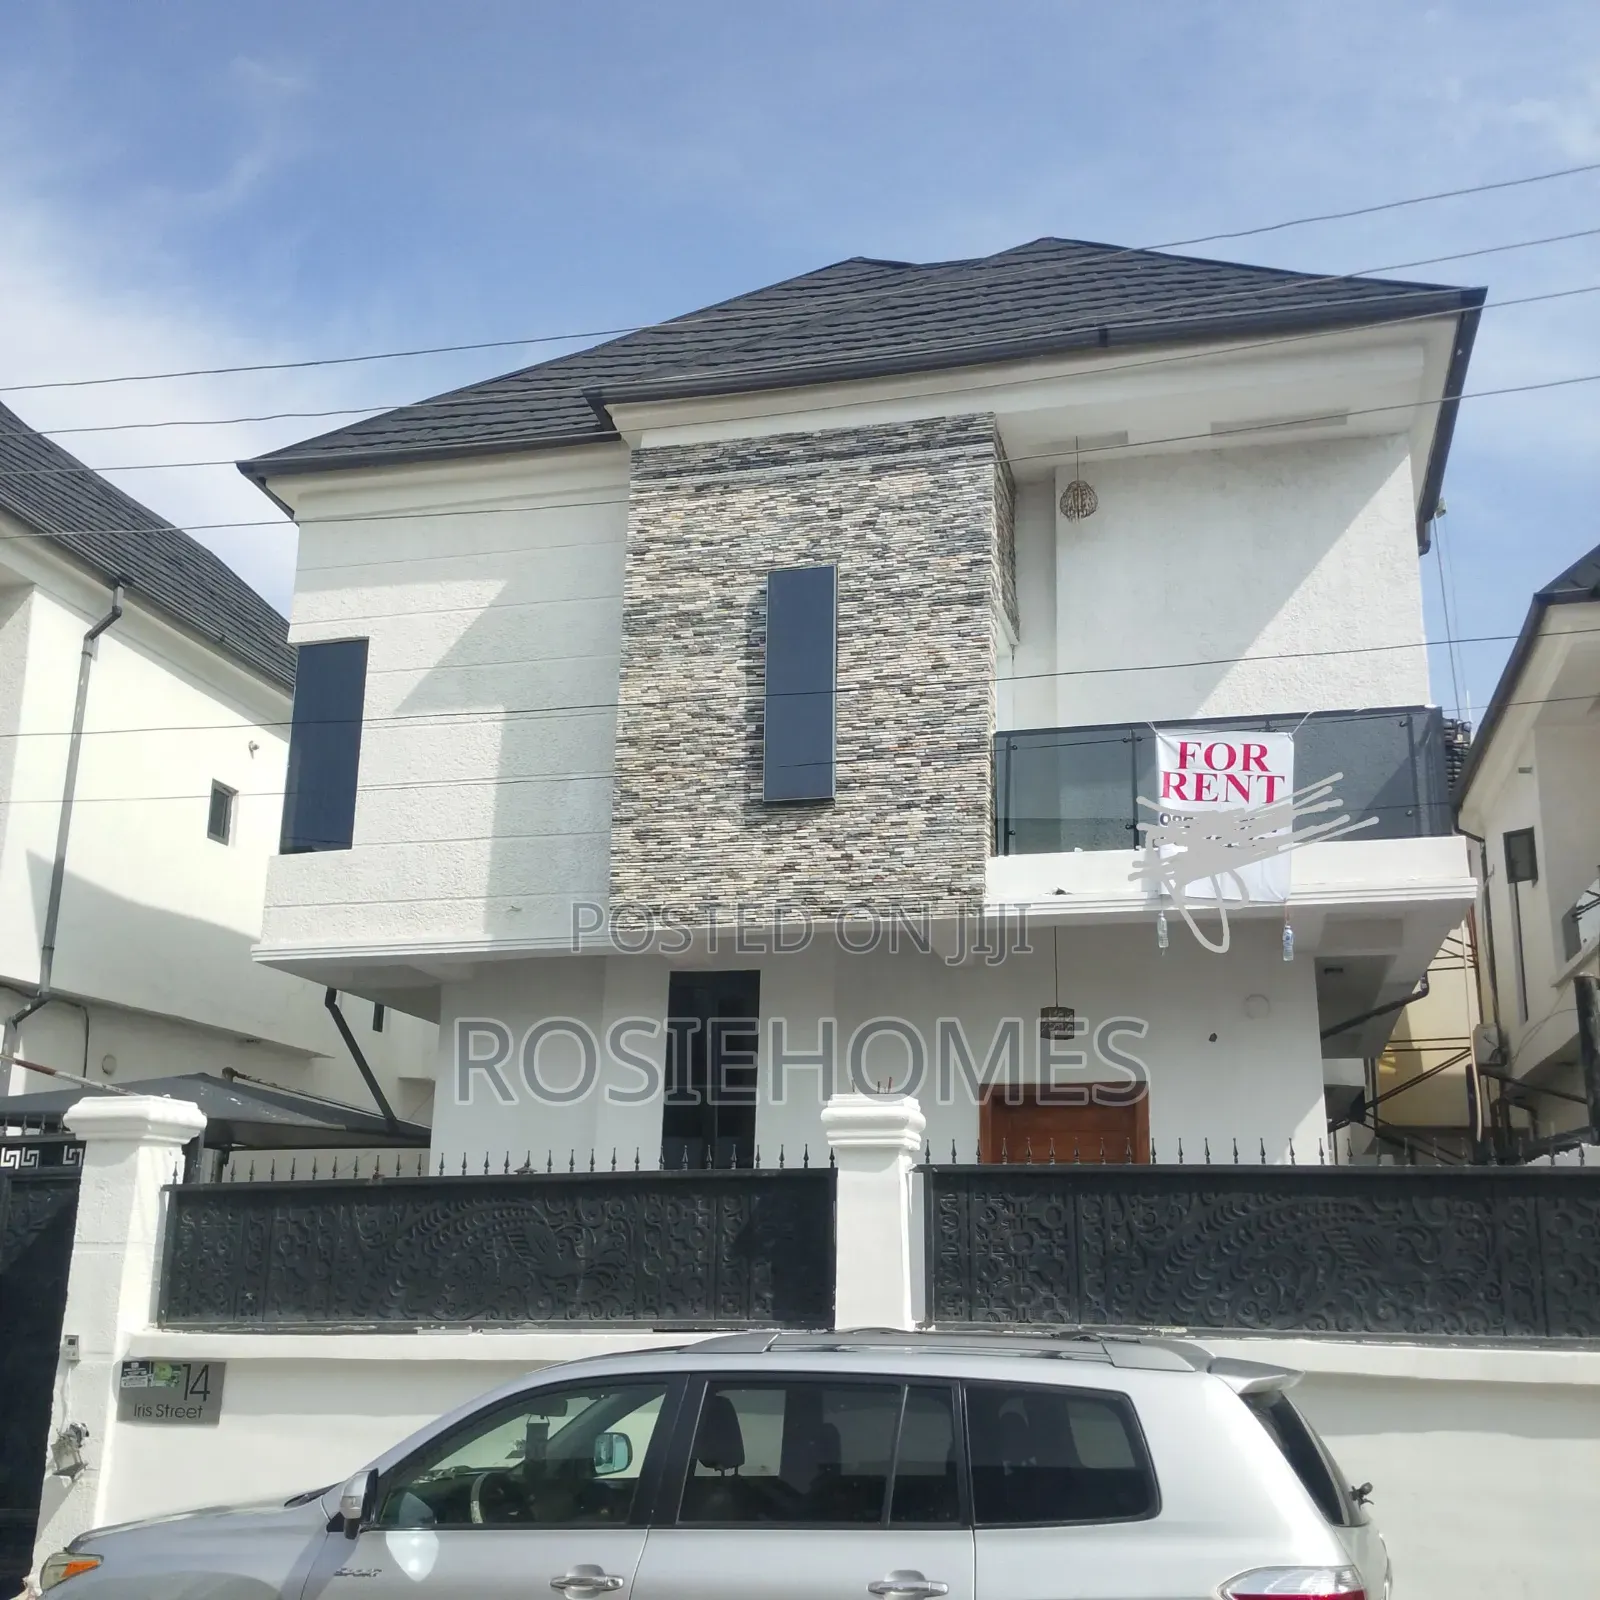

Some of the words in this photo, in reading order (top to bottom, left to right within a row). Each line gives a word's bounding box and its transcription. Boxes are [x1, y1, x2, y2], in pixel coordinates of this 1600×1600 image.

[1177, 741, 1271, 772] FOR
[1160, 771, 1285, 804] RENT
[182, 1363, 211, 1402] 14
[133, 1404, 152, 1417] Iris
[156, 1404, 203, 1418] Street
